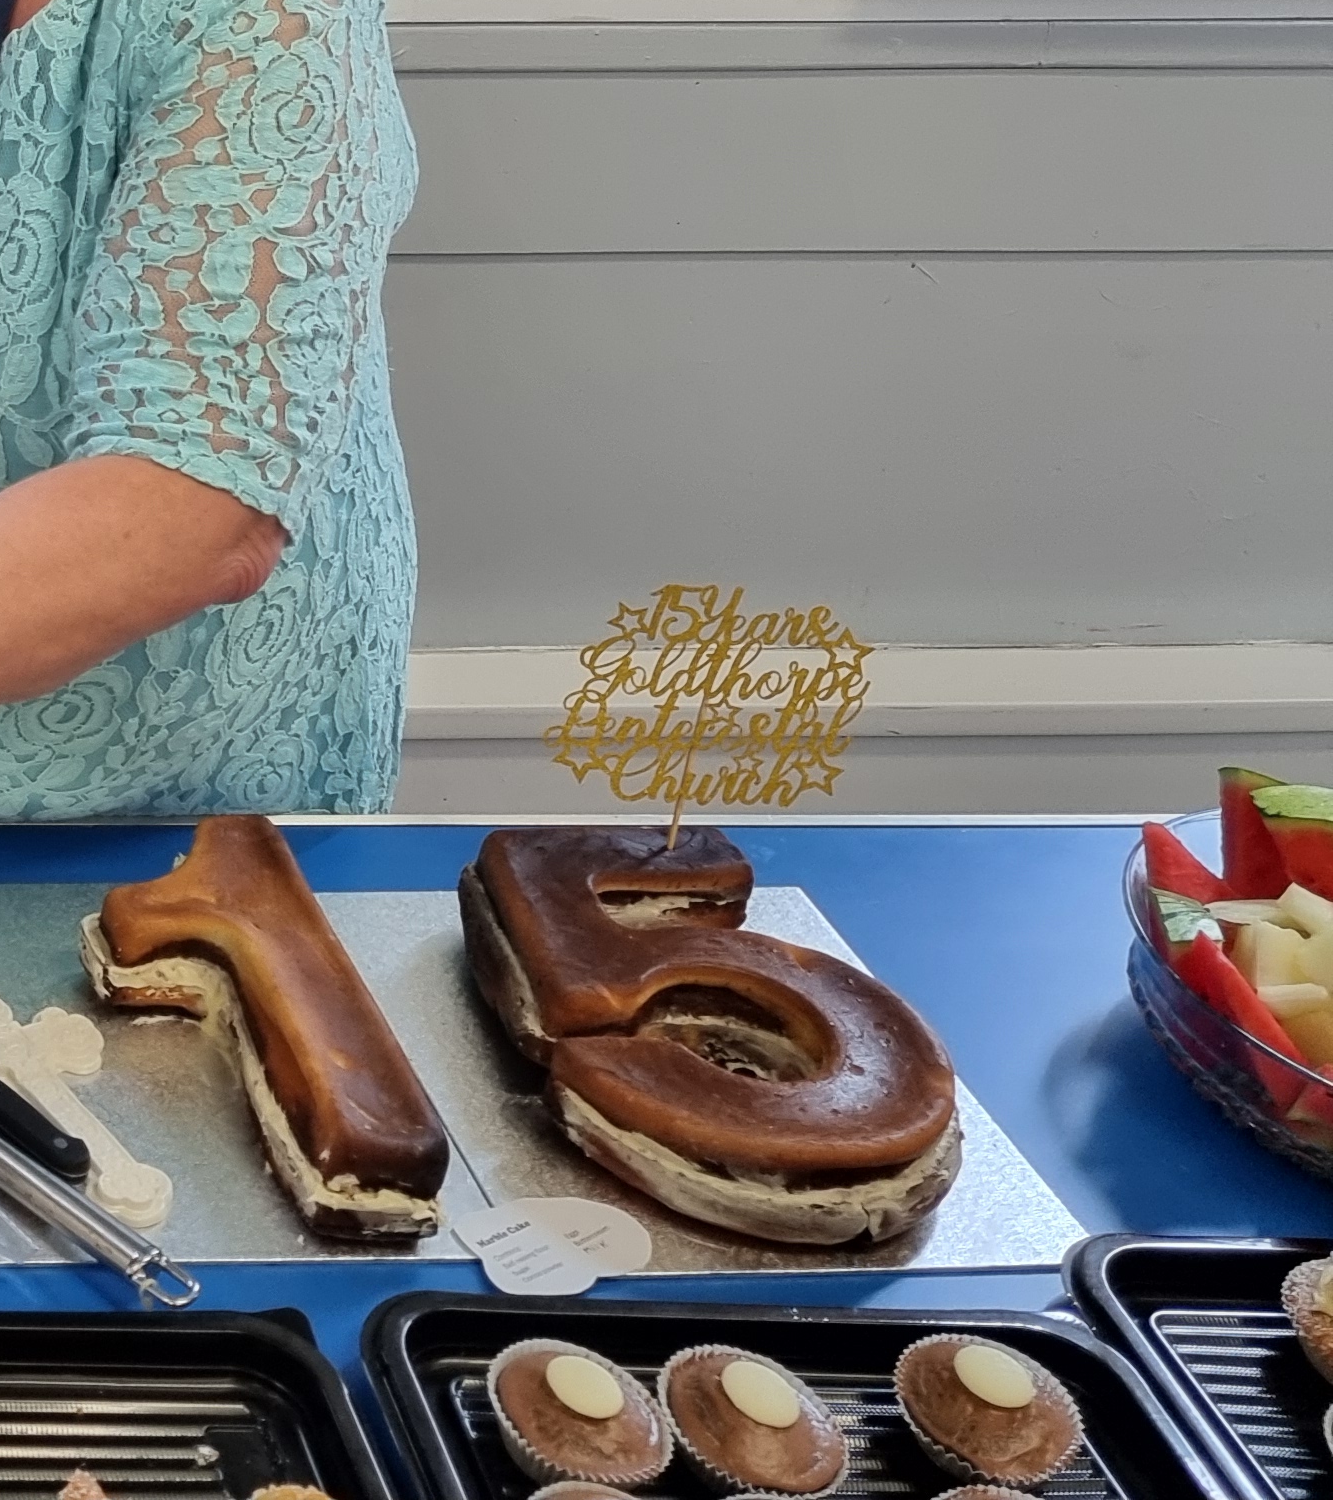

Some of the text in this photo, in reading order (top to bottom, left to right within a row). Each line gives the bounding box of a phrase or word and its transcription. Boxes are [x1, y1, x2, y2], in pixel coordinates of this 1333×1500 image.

[650, 584, 839, 650] 15 Years
[579, 636, 871, 708] Goldthorpe
[609, 746, 805, 807] Church
[475, 1220, 531, 1248] Marble Cake
